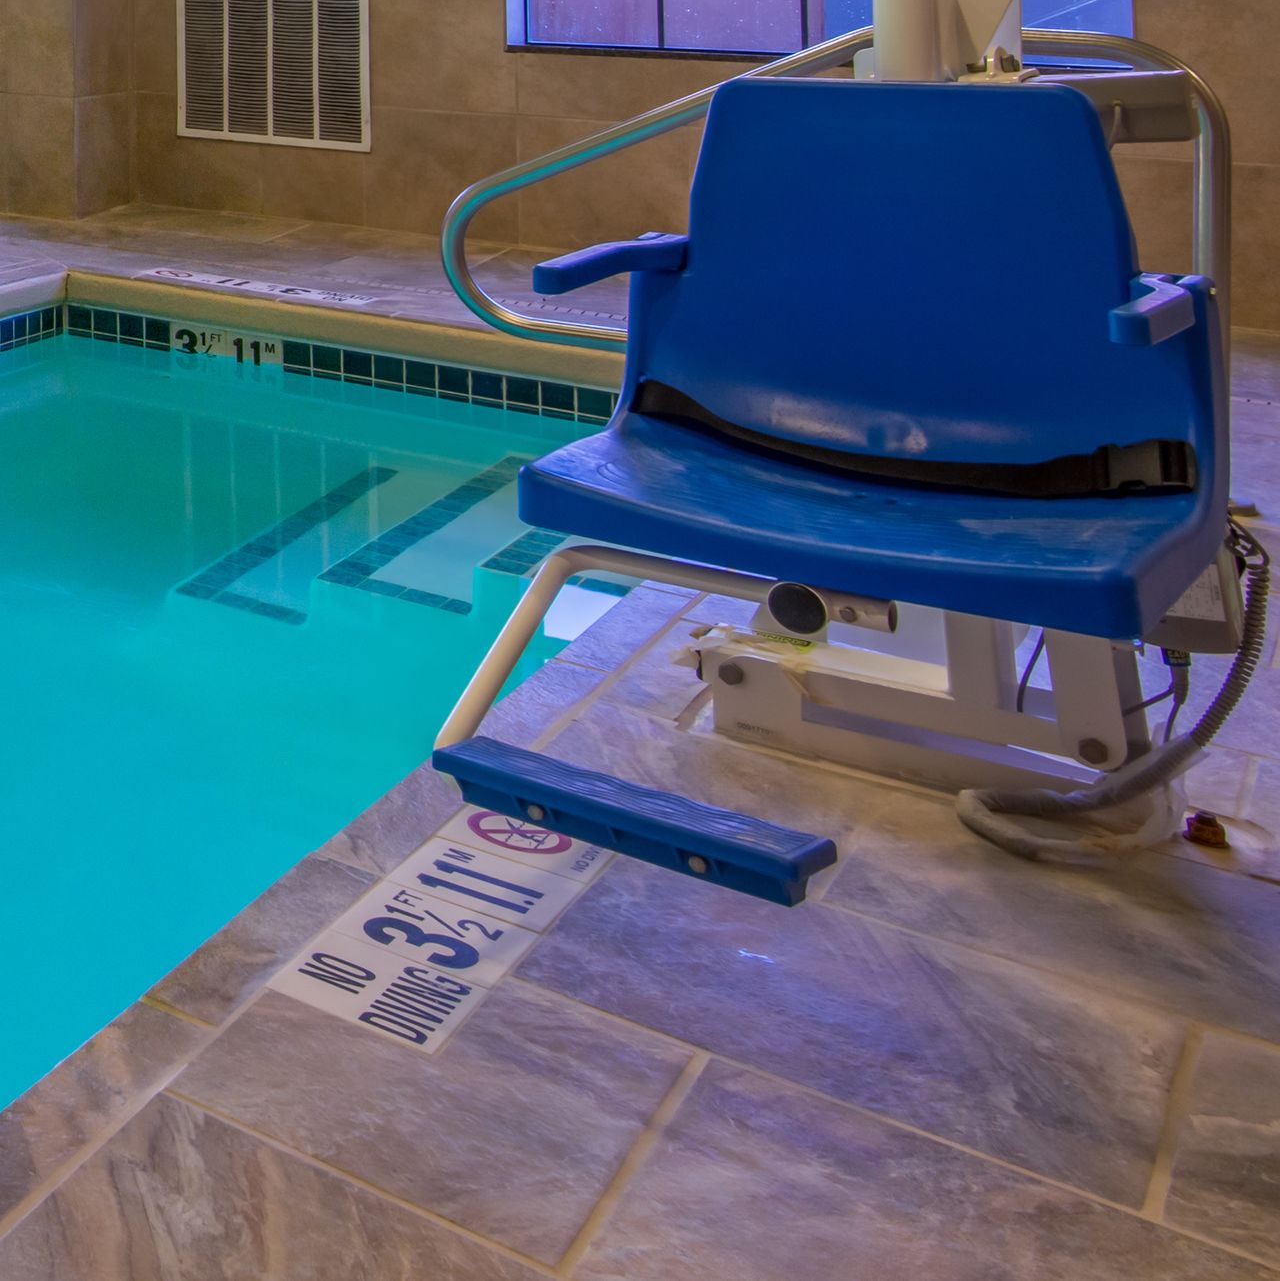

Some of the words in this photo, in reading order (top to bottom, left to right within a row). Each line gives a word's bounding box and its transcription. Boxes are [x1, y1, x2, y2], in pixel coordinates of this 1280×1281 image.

[210, 333, 222, 343] FT
[264, 342, 276, 354] M
[443, 847, 476, 864] M
[393, 889, 424, 909] FT
[297, 952, 377, 995] NO
[358, 966, 473, 1045] DIVING
